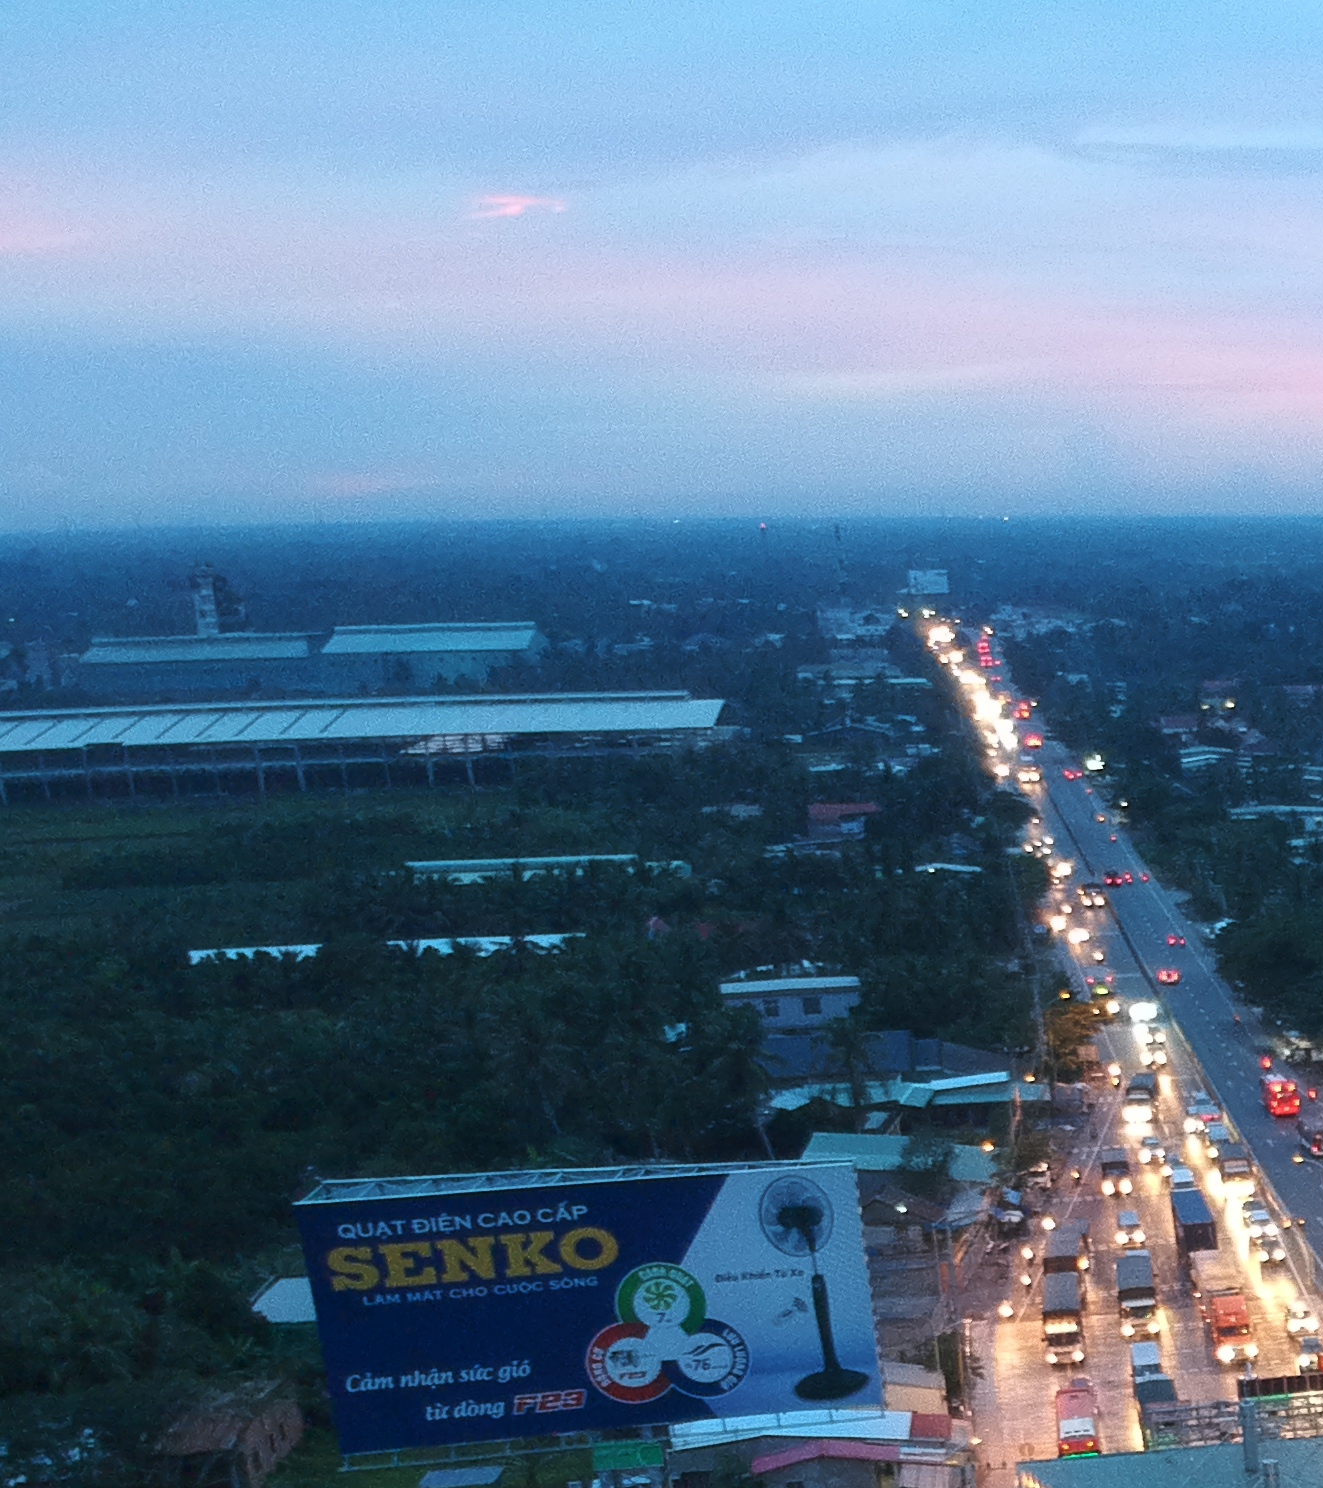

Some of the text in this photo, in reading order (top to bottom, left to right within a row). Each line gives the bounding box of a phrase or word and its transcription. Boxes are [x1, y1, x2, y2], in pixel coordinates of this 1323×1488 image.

[337, 1201, 588, 1240] QUẠT ĐIỆN CAO CẤP
[327, 1227, 619, 1292] SENKO
[449, 1286, 488, 1299] CHO
[346, 1359, 531, 1392] Cảm nhận sức gió
[425, 1388, 587, 1421] từ dòng F23
